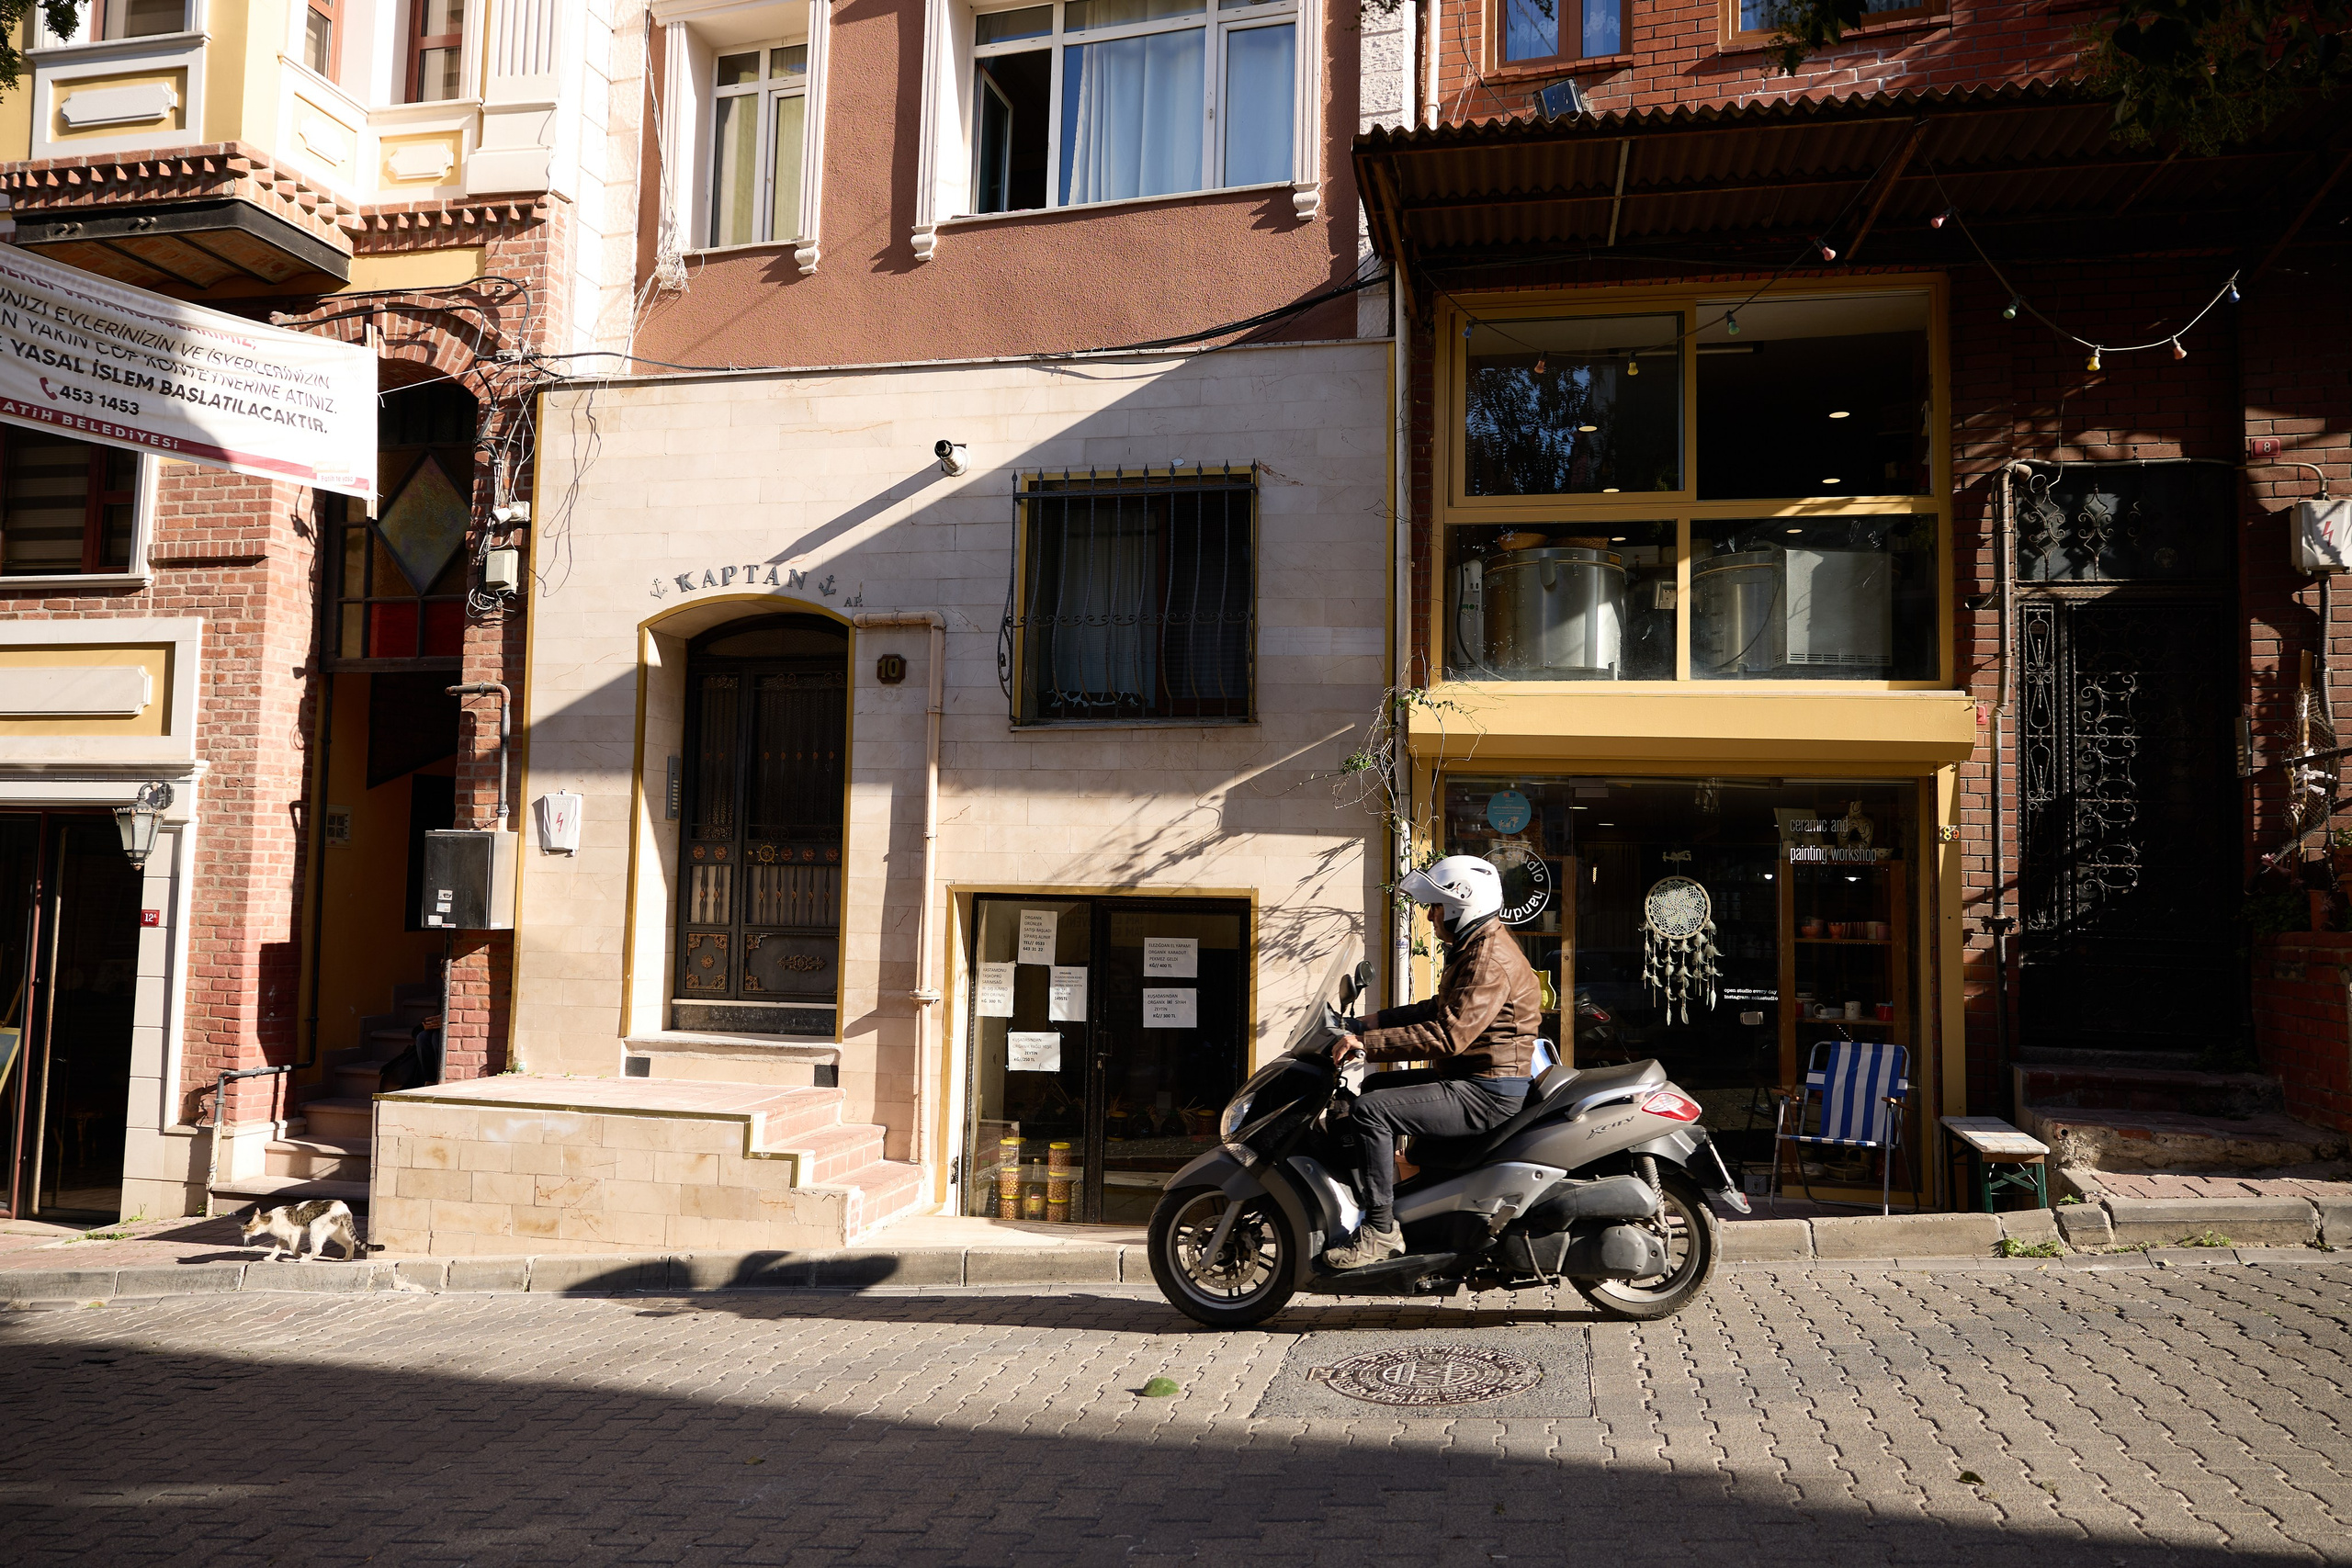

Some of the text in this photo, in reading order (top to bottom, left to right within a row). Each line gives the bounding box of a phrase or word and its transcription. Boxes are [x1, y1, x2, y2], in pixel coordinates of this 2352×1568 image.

[55, 306, 176, 353] EVLERİNİZİN
[181, 343, 205, 361] VE
[27, 317, 88, 349] YAKIN
[286, 389, 337, 414] ATINIZ.
[11, 338, 85, 375] YASAL
[92, 359, 154, 391] İŞLEM
[159, 379, 328, 434] BAŞLATILACAKTIR.
[59, 385, 141, 416] 453 1453
[2263, 442, 2271, 453] 8
[674, 564, 808, 593] KAPTAN
[877, 658, 899, 678] 10
[1790, 816, 1849, 832] ceramic and
[1507, 849, 1544, 883] studio
[1790, 845, 1877, 865] painting workshop
